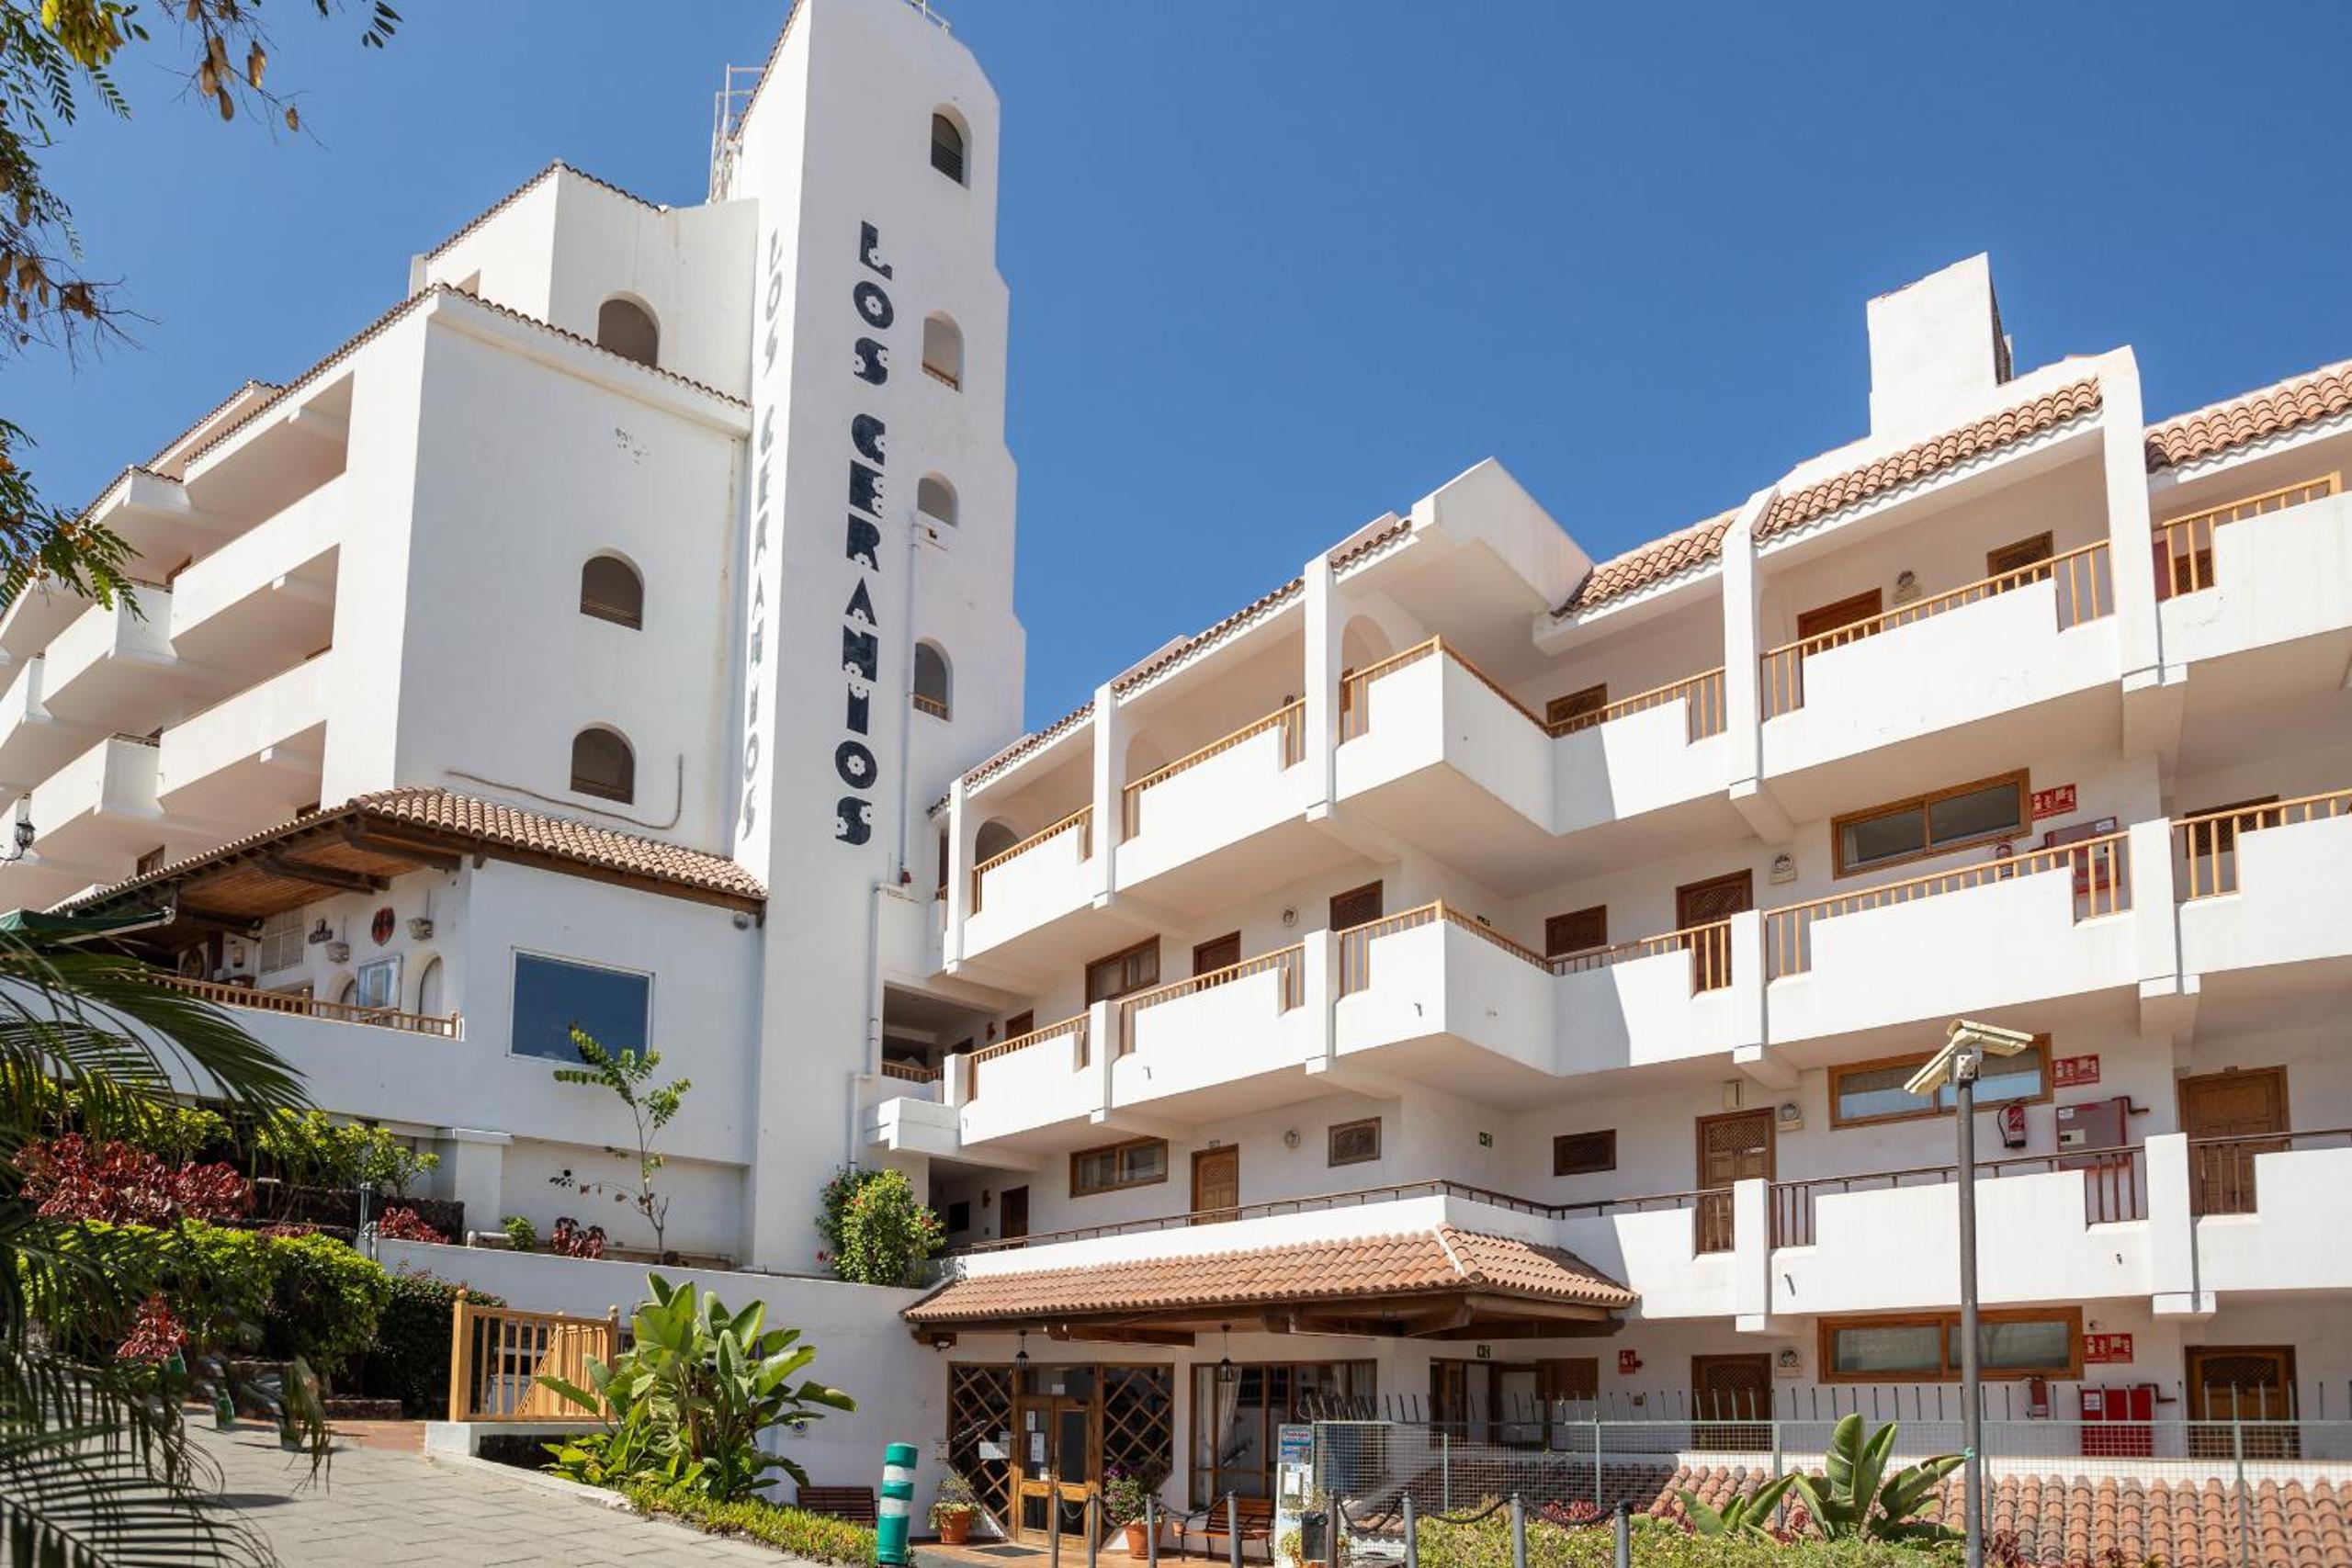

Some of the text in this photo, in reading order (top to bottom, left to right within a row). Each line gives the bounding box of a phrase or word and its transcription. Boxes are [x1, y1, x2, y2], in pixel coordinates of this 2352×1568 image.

[764, 228, 783, 378] LOS
[834, 220, 894, 846] LOS GERANIOS
